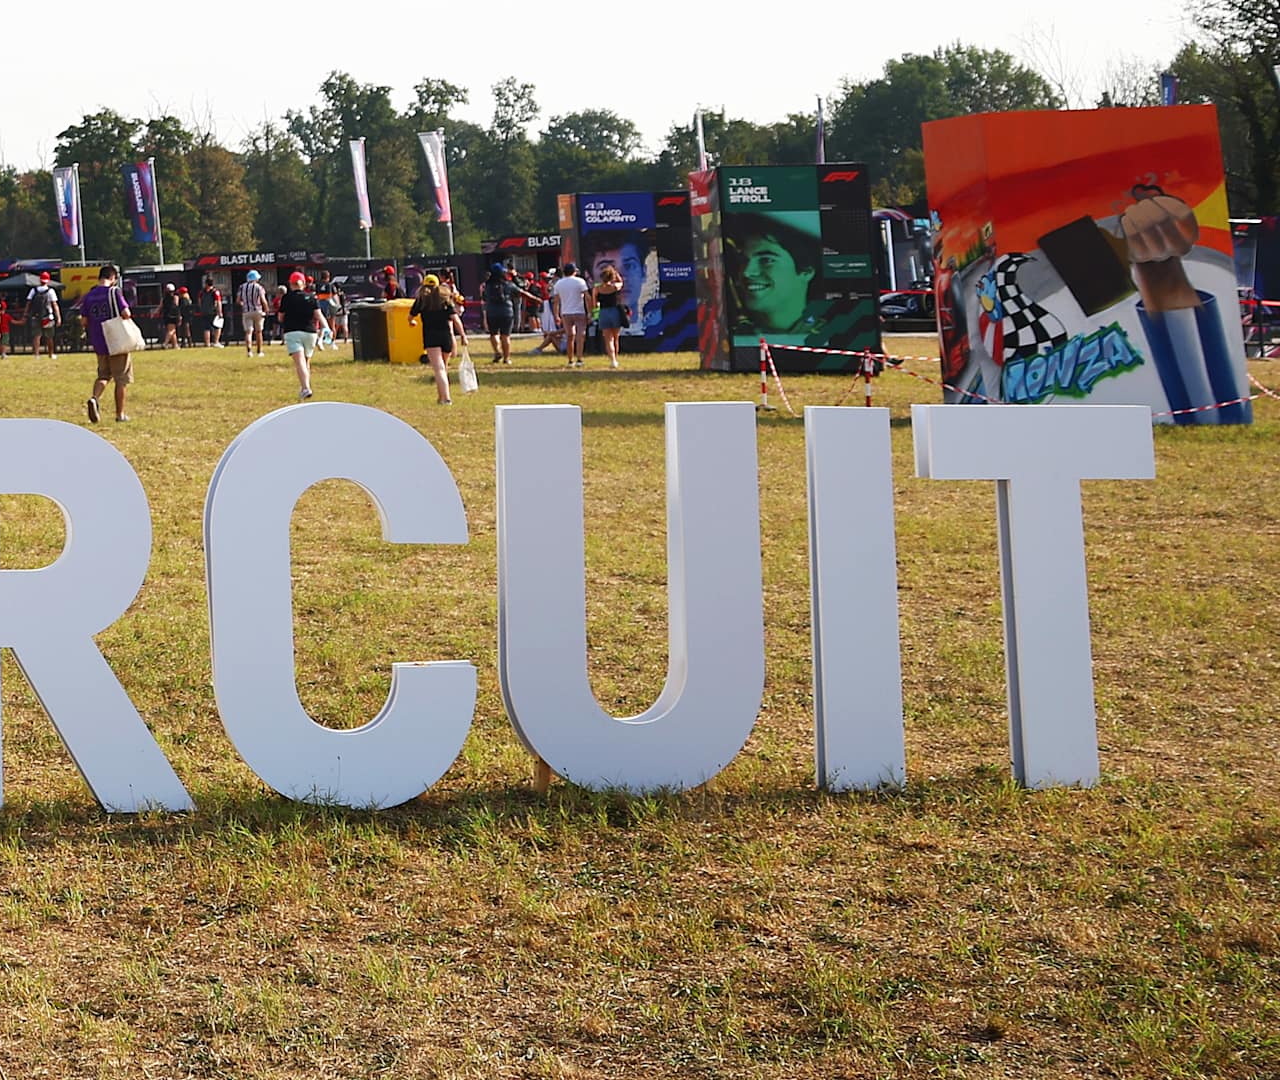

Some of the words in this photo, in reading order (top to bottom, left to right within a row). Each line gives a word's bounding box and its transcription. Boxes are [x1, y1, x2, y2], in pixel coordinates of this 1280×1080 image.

[729, 178, 753, 186] 18
[729, 186, 768, 195] LANCE
[729, 195, 772, 203] STROLL
[584, 209, 622, 217] FRANCO
[585, 215, 636, 223] COLAPINTO
[527, 235, 562, 248] BLAST
[220, 254, 248, 265] BLAST
[249, 252, 275, 264] LANE
[1004, 327, 1142, 403] MONZA
